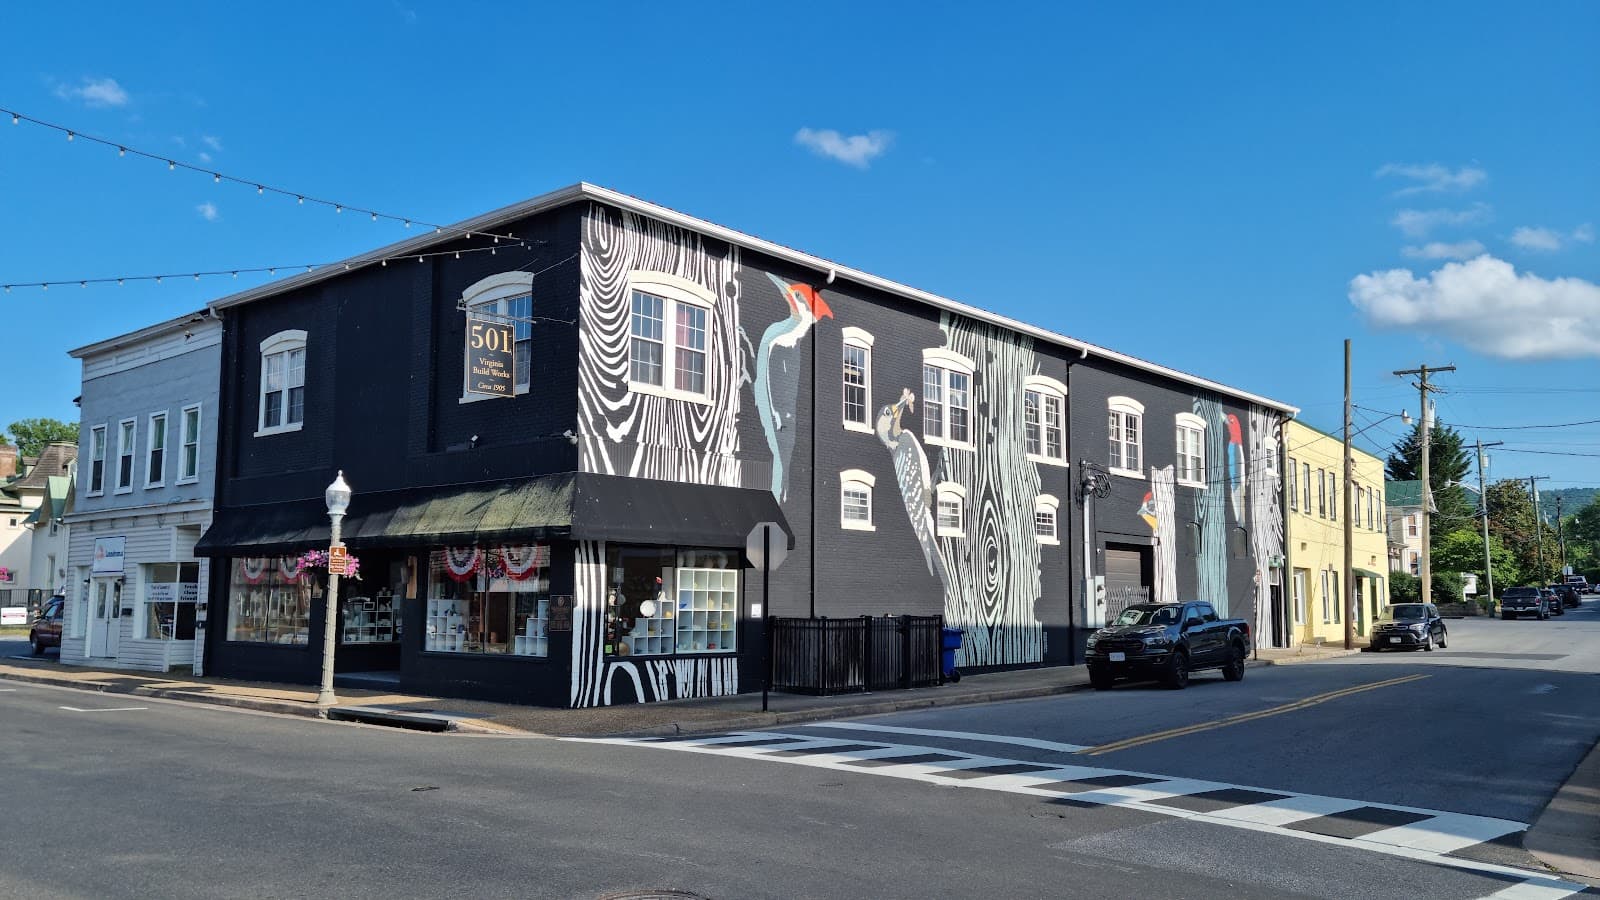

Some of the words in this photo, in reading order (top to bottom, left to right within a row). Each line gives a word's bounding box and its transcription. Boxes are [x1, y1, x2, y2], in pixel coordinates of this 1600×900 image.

[471, 325, 511, 353] 501
[480, 358, 504, 368] Virginia
[473, 366, 490, 375] Build
[491, 368, 510, 378] Works
[478, 382, 492, 390] Circa
